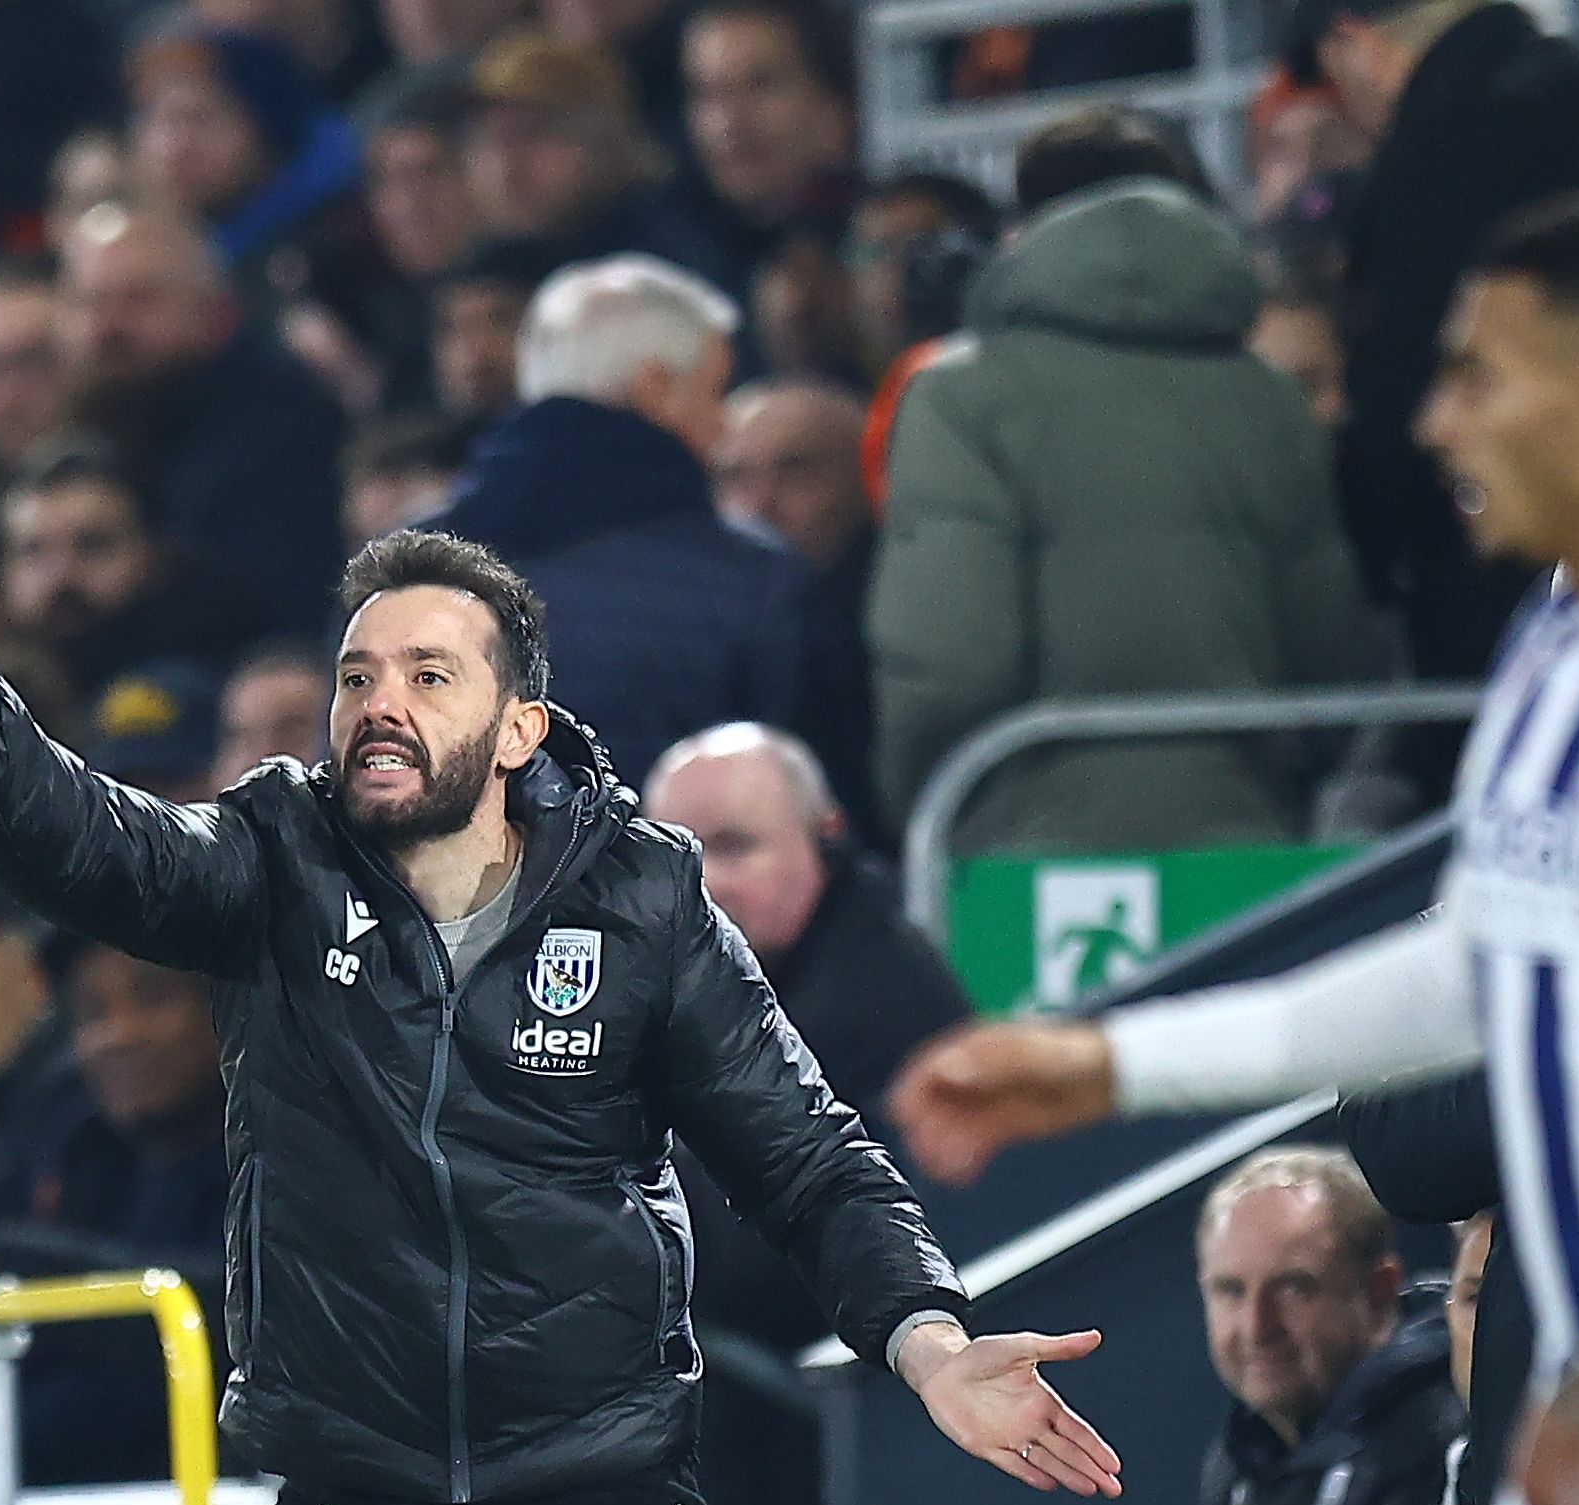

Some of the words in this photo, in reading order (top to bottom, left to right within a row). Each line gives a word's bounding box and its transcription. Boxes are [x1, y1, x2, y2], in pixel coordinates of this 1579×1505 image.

[538, 945, 591, 957] ALBION
[325, 948, 361, 985] CC
[512, 1018, 602, 1057] ideal
[518, 1055, 587, 1070] HEATING
